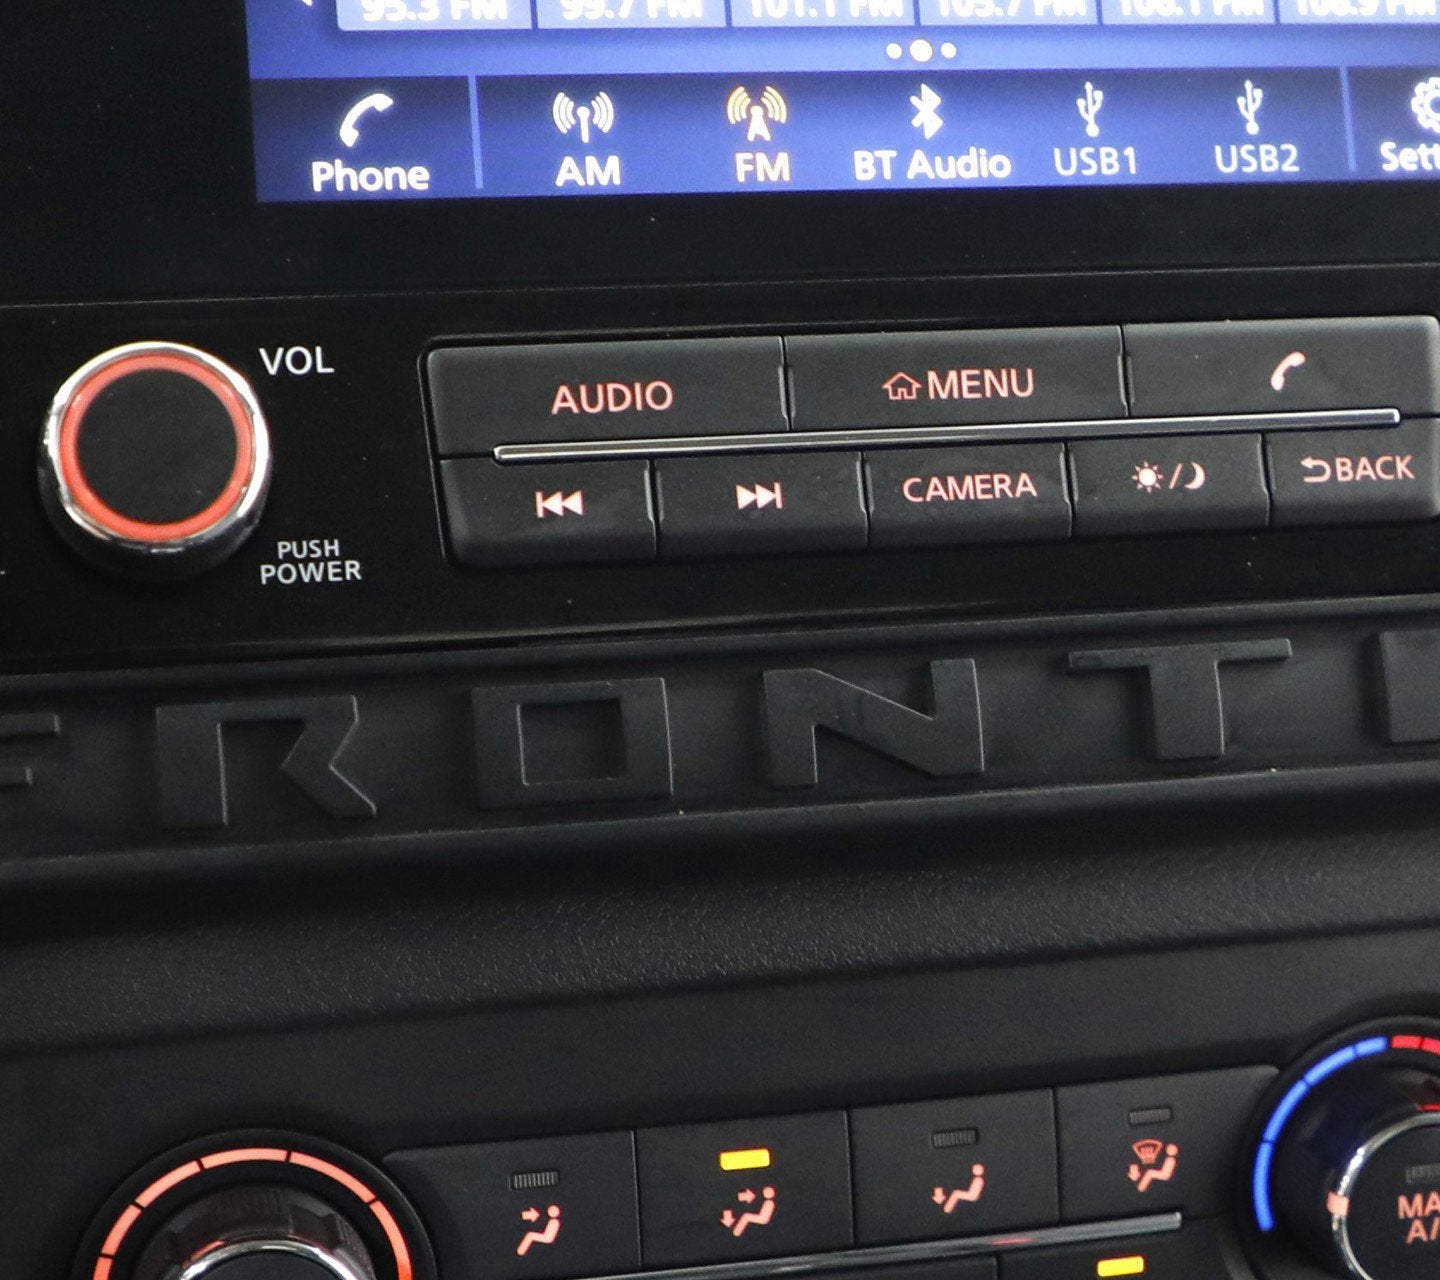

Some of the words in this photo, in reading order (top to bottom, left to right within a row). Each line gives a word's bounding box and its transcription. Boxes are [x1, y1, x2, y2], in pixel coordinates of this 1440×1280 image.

[555, 156, 621, 186] AM
[735, 152, 790, 182] FM
[854, 150, 896, 180] BT
[907, 146, 1011, 179] Audio
[1054, 146, 1138, 176] USB1
[1215, 144, 1300, 173] USB2
[312, 160, 429, 193] Phone
[260, 347, 334, 375] VOL
[551, 382, 673, 415] AUDIO
[927, 368, 1034, 399] MENU
[1336, 455, 1414, 483] BACK
[903, 472, 1038, 503] CAMERA
[277, 539, 340, 559] PUSH
[260, 560, 362, 585] POWER
